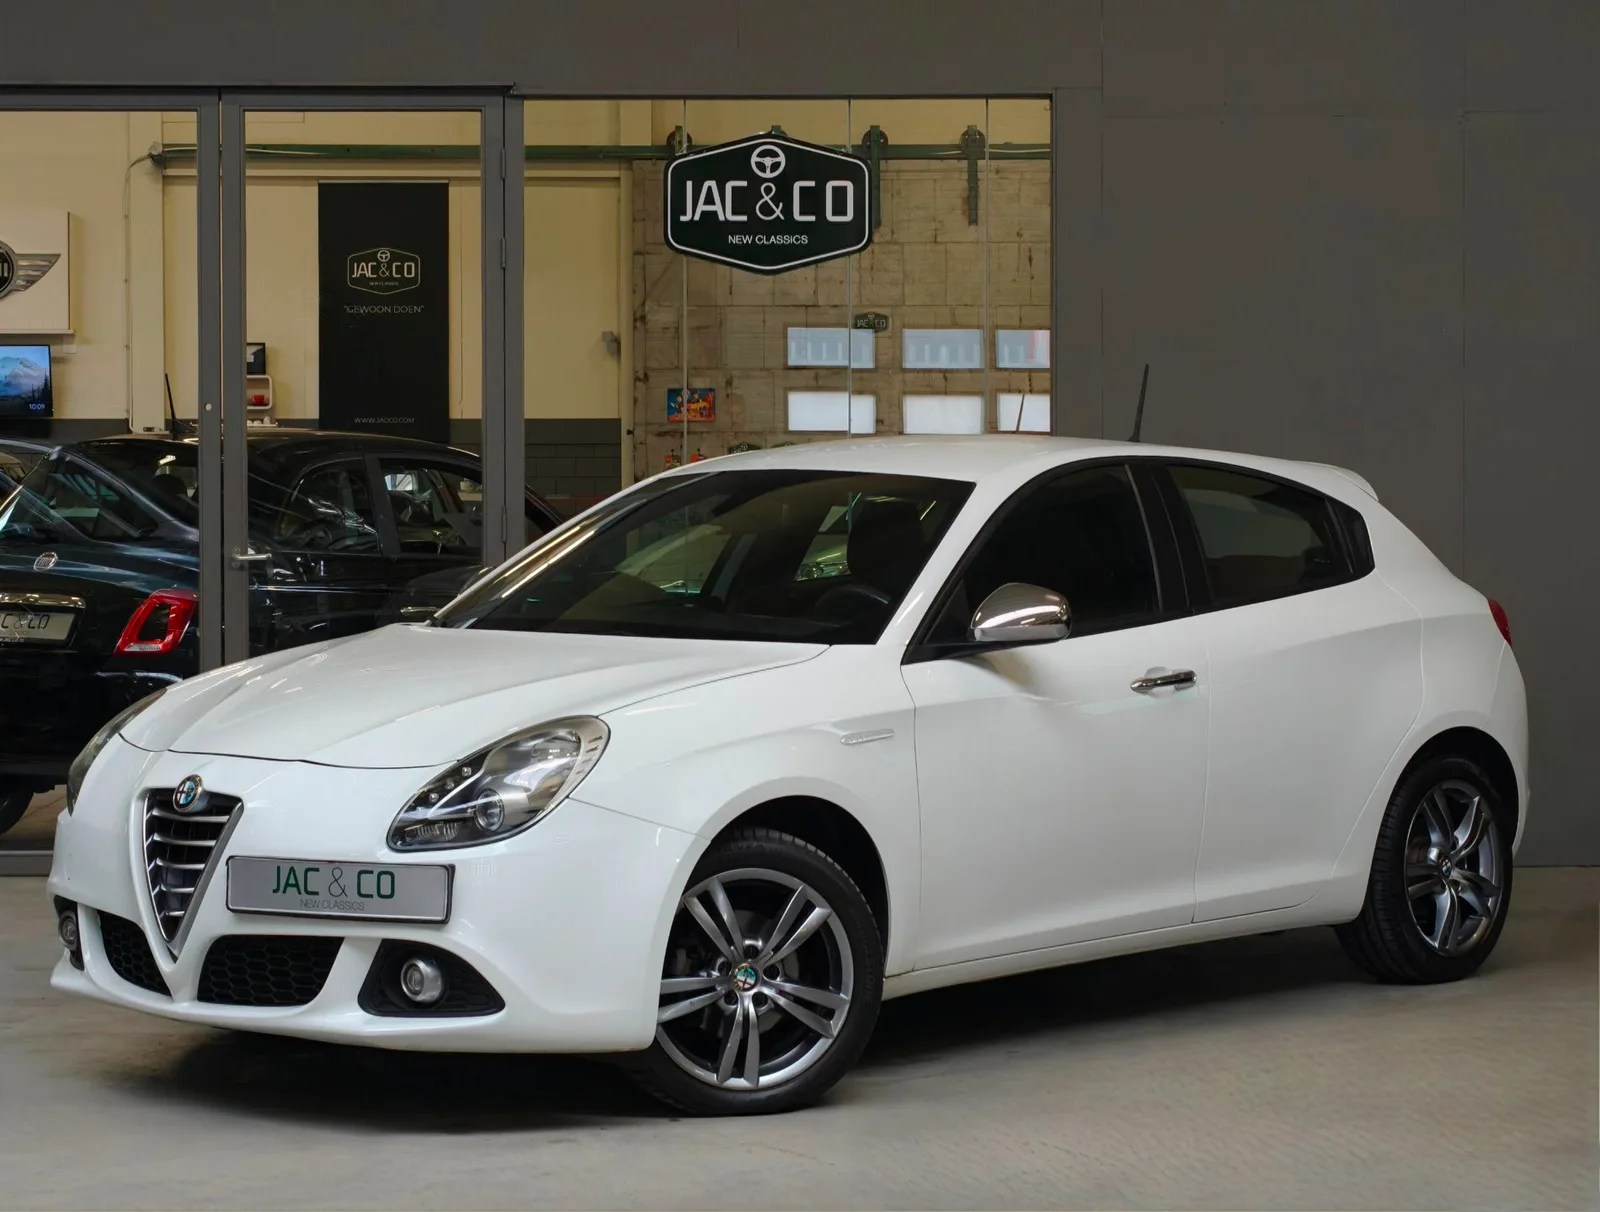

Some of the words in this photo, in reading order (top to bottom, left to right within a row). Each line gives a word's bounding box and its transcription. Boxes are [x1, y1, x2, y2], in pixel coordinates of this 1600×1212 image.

[680, 180, 748, 222] JAC
[755, 182, 785, 221] &
[793, 180, 854, 222] CO
[728, 235, 753, 244] NEW
[755, 234, 809, 245] CLASSICS
[351, 262, 377, 278] JAC
[379, 262, 390, 278] &
[392, 262, 416, 278] CO
[272, 865, 320, 896] JAC
[327, 866, 348, 898] &
[356, 869, 396, 899] CO
[300, 898, 320, 909] NEW
[321, 899, 366, 911] CLASSICS
